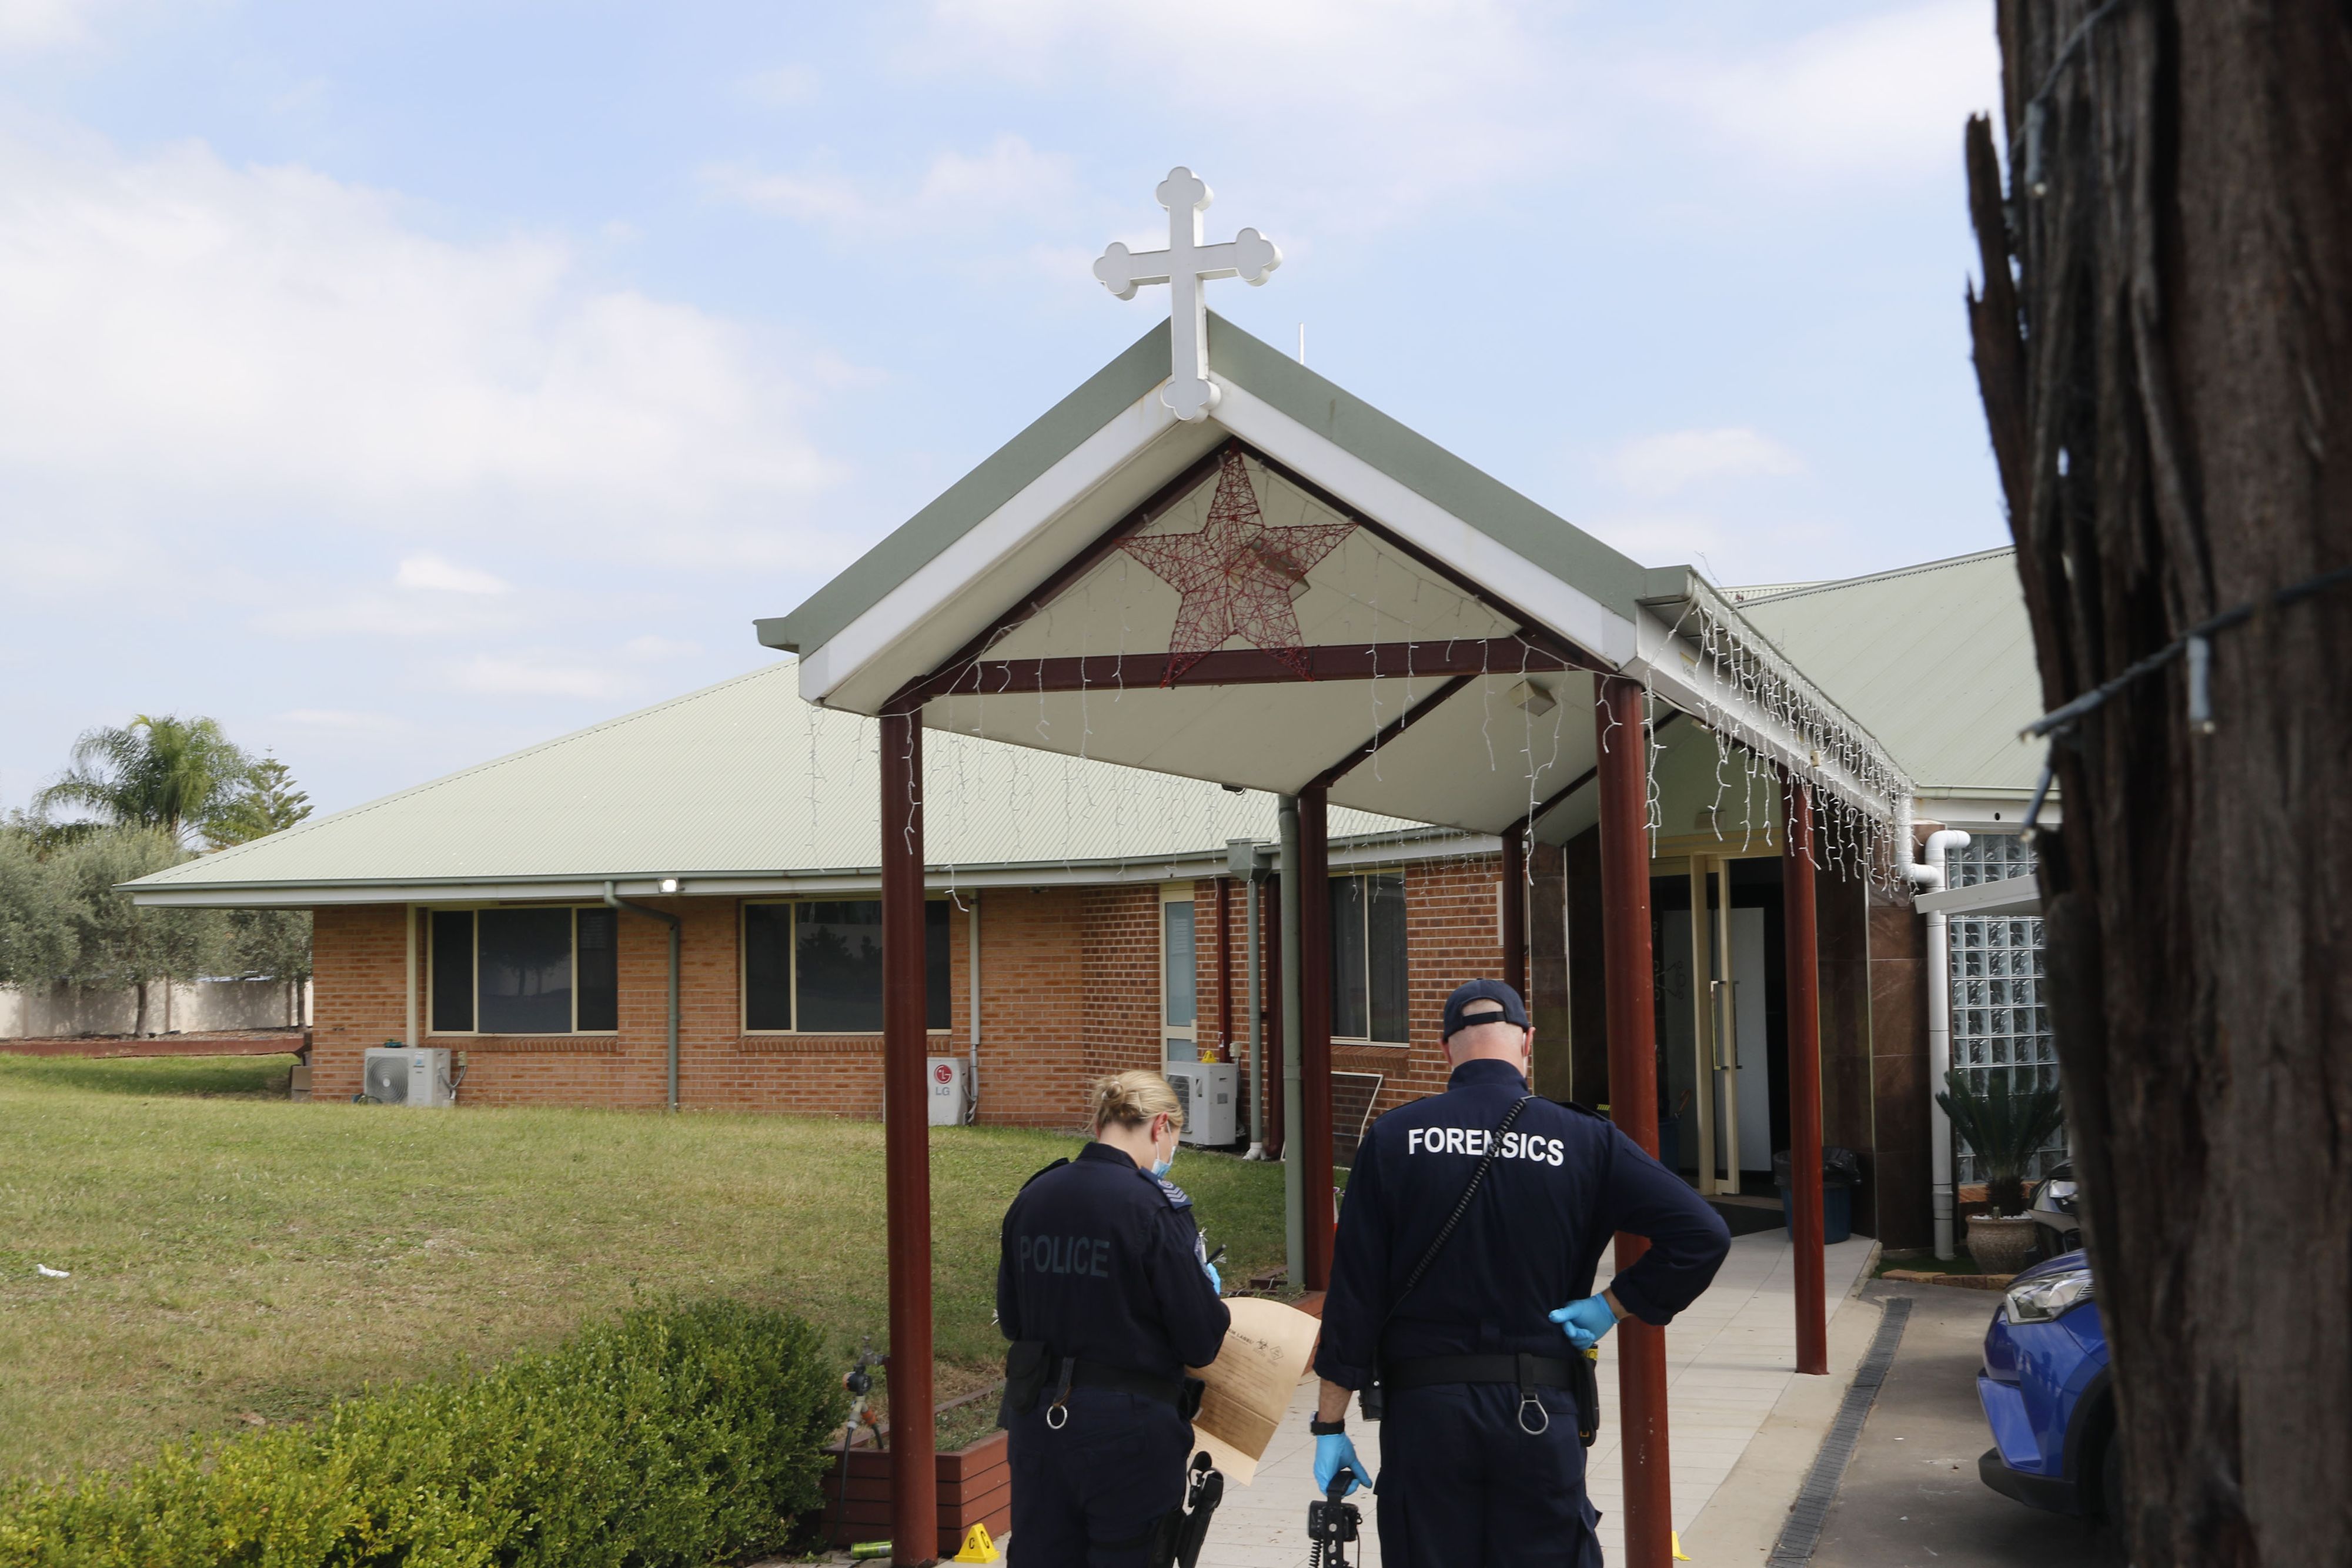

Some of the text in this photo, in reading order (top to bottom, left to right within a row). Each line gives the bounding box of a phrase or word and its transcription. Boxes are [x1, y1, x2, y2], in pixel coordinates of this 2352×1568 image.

[936, 1086, 950, 1096] LG
[1408, 1126, 1565, 1166] FORENSICS
[1020, 1234, 1110, 1278] POLICE
[969, 1537, 975, 1549] C
